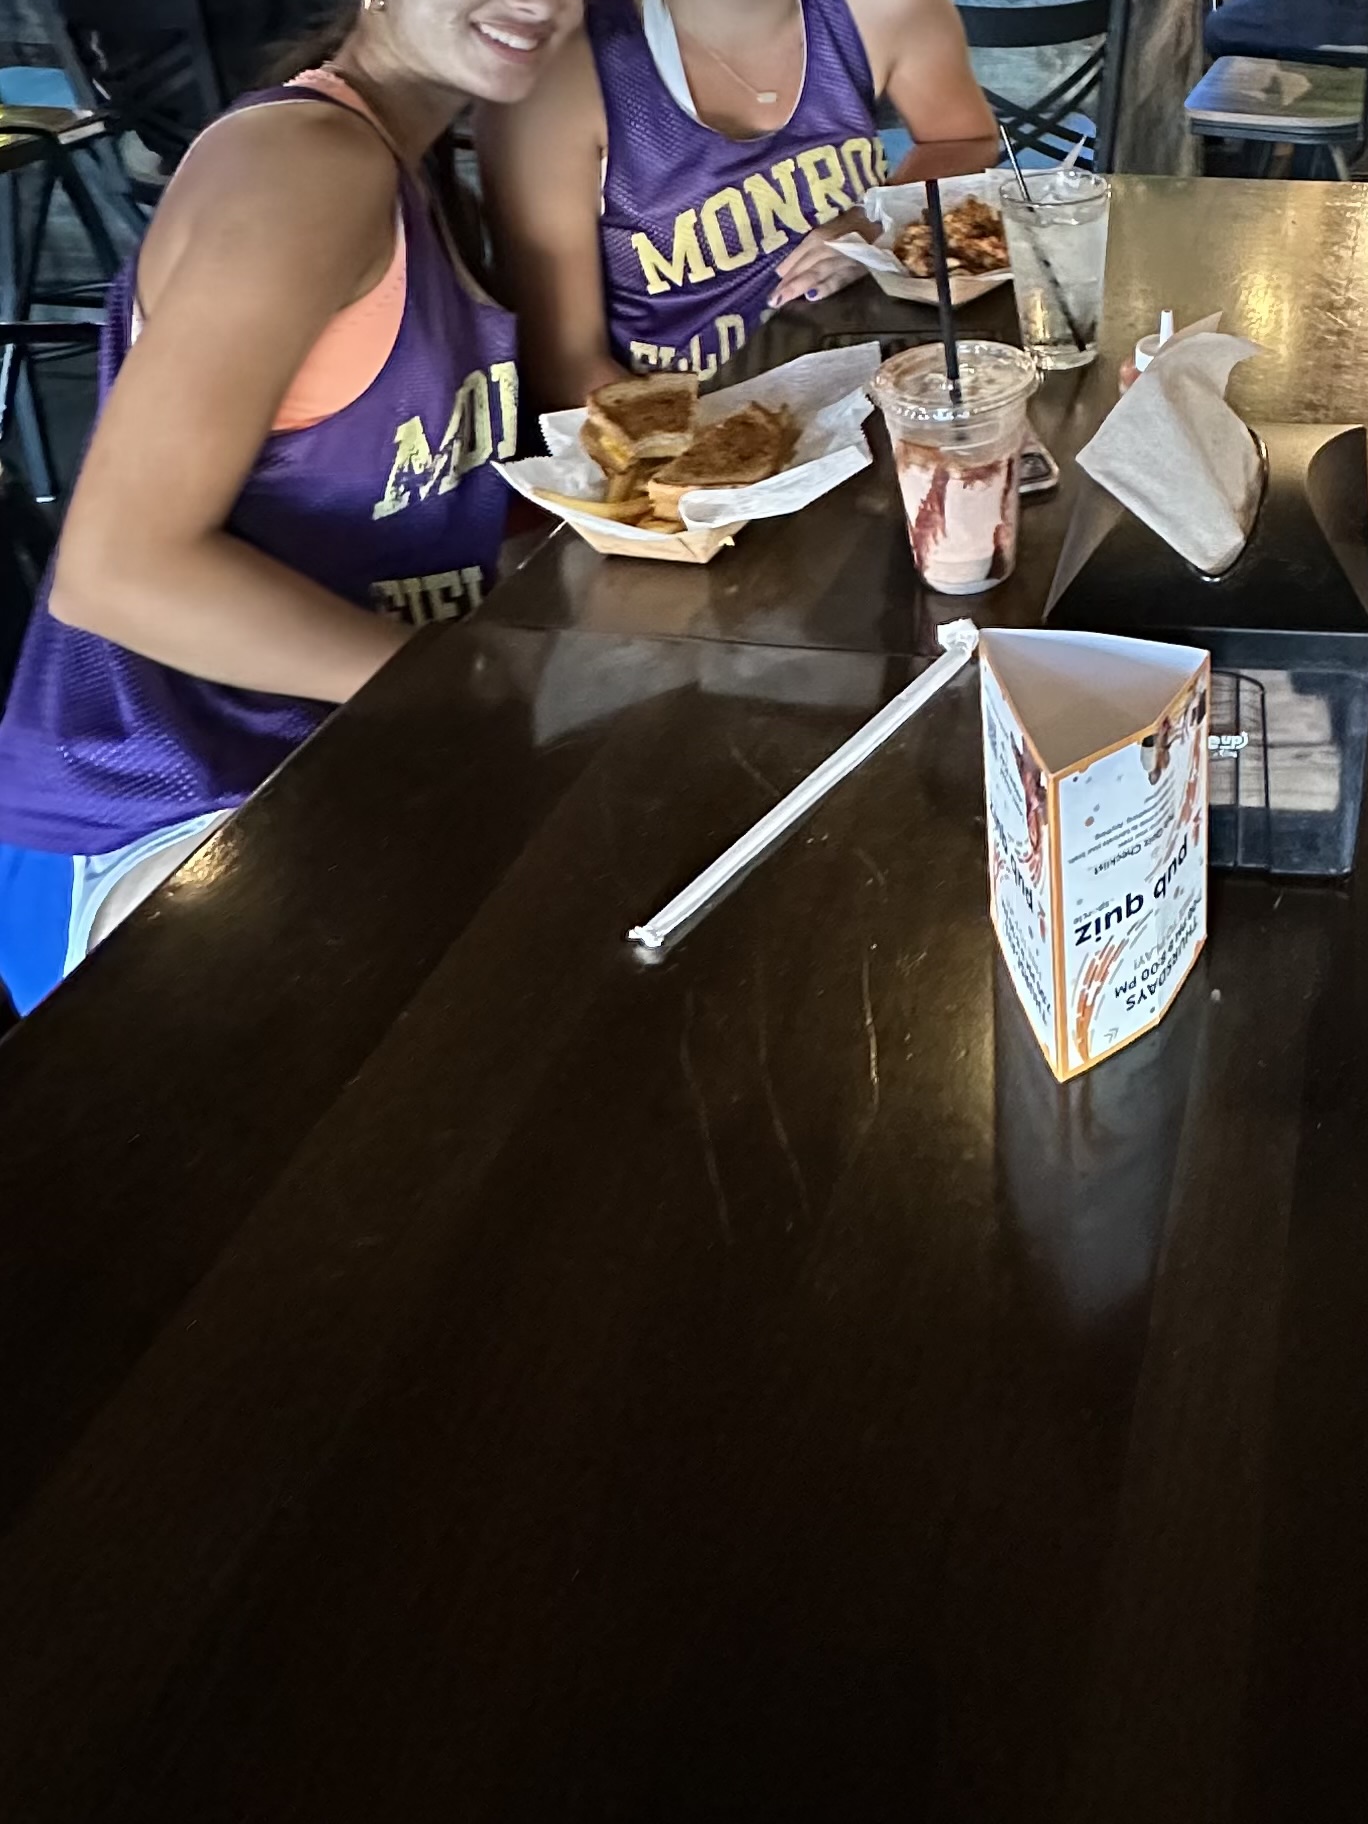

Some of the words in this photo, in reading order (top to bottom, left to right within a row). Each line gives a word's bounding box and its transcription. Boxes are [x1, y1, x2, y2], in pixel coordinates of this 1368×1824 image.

[1094, 841, 1142, 875] Checklist
[1153, 832, 1188, 899] pub
[1074, 893, 1144, 946] quiz
[1114, 976, 1137, 998] PM
[1125, 916, 1198, 1012] THURSDAYS
